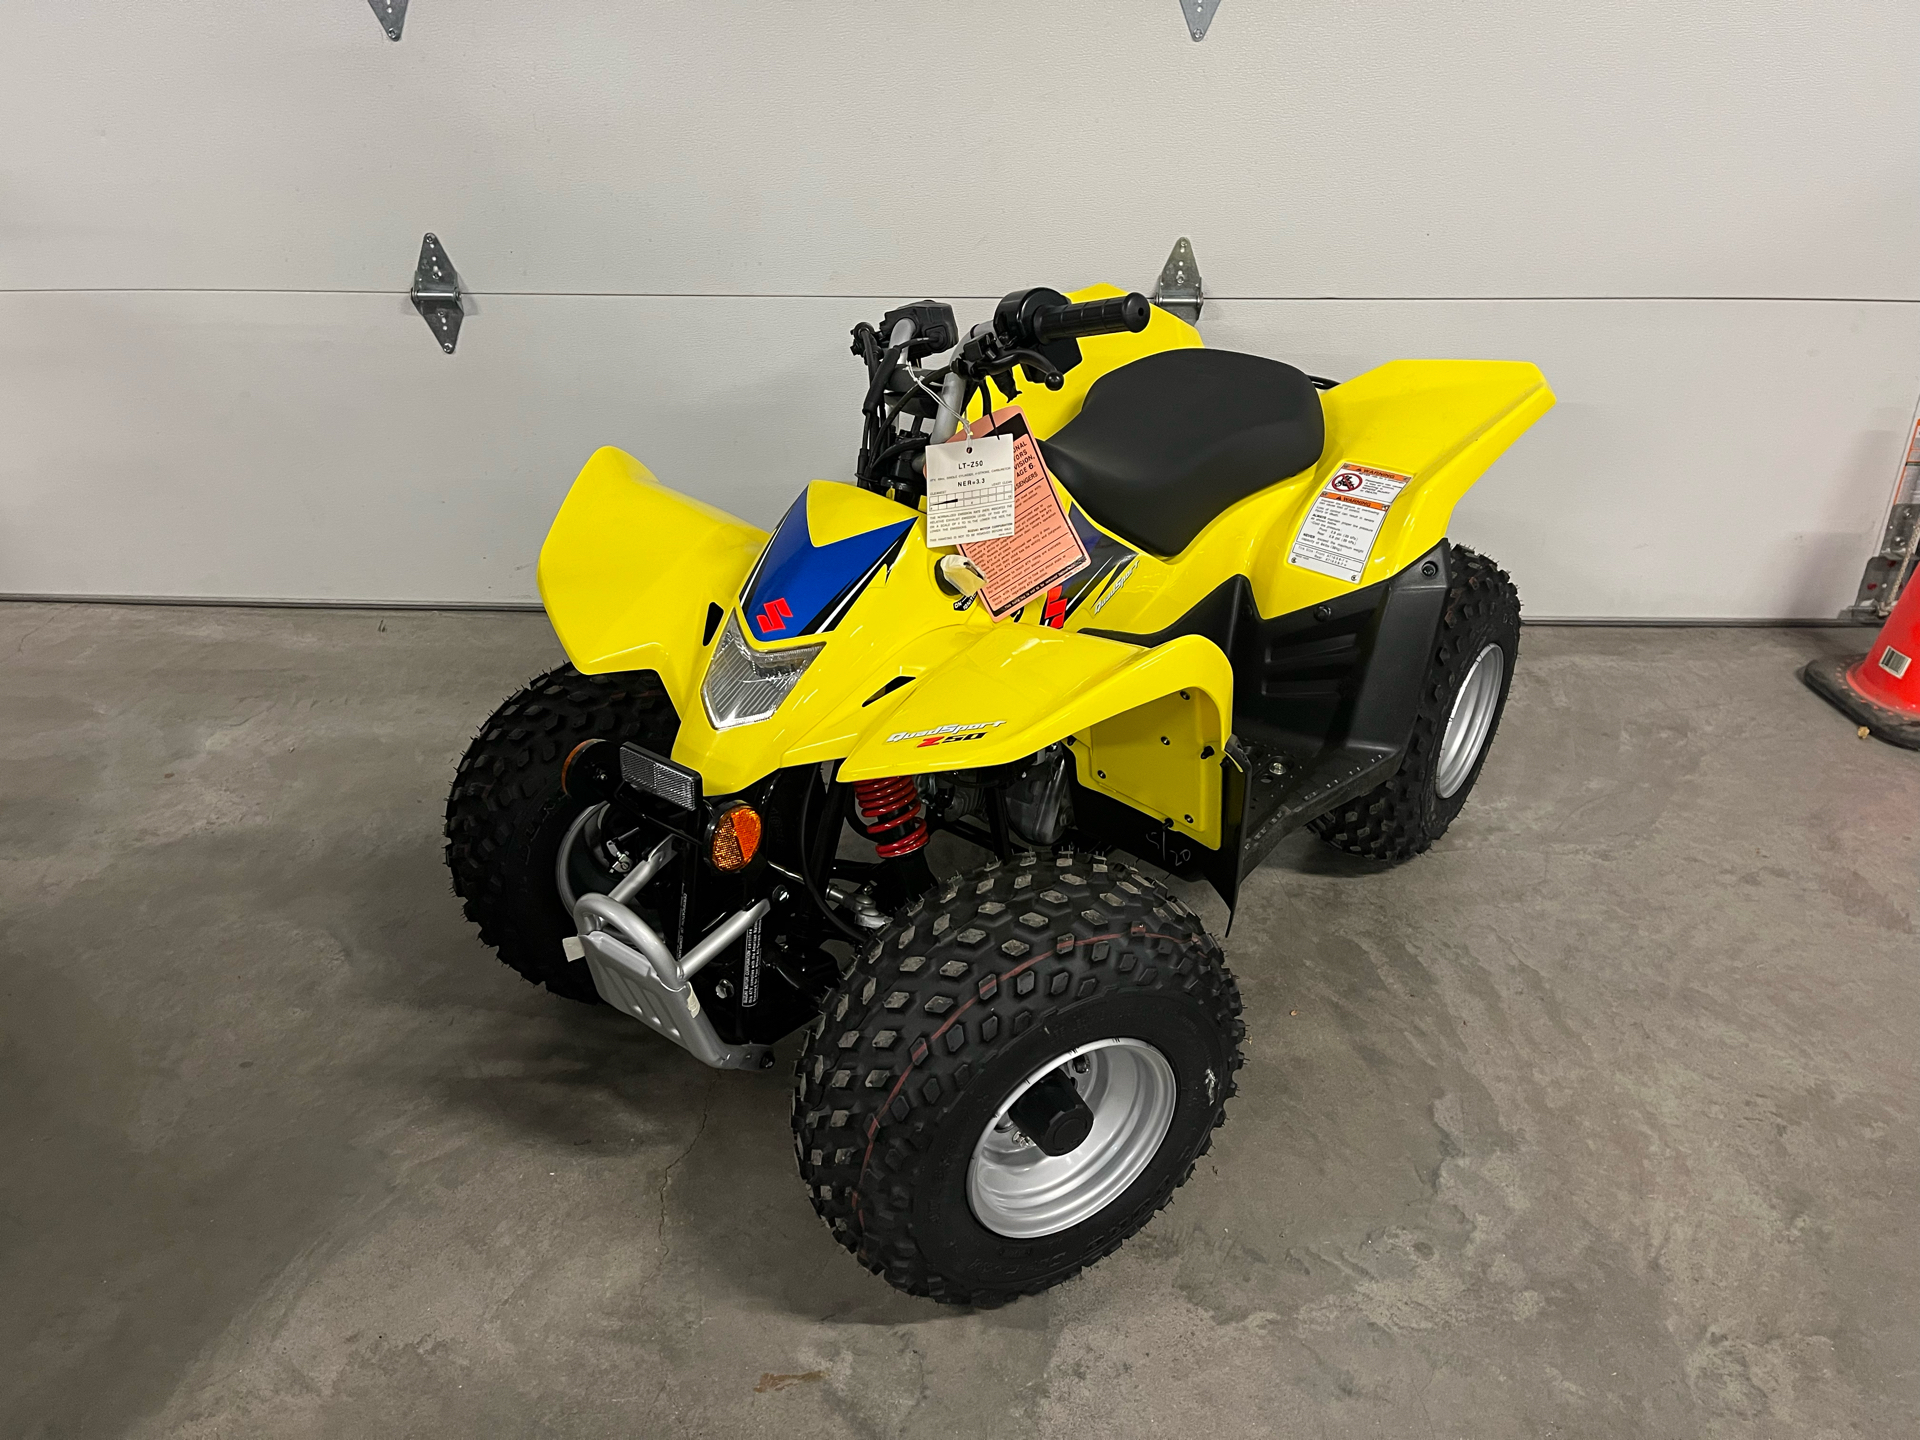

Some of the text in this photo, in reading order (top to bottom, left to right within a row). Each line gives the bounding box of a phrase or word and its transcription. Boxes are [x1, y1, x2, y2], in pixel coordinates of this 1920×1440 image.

[958, 460, 984, 470] LT-Z50
[1017, 467, 1028, 478] AGE
[1363, 468, 1396, 479] WARNING
[1342, 496, 1372, 507] WARNING
[886, 720, 1007, 743] QuadSport
[916, 731, 988, 748] Z50
